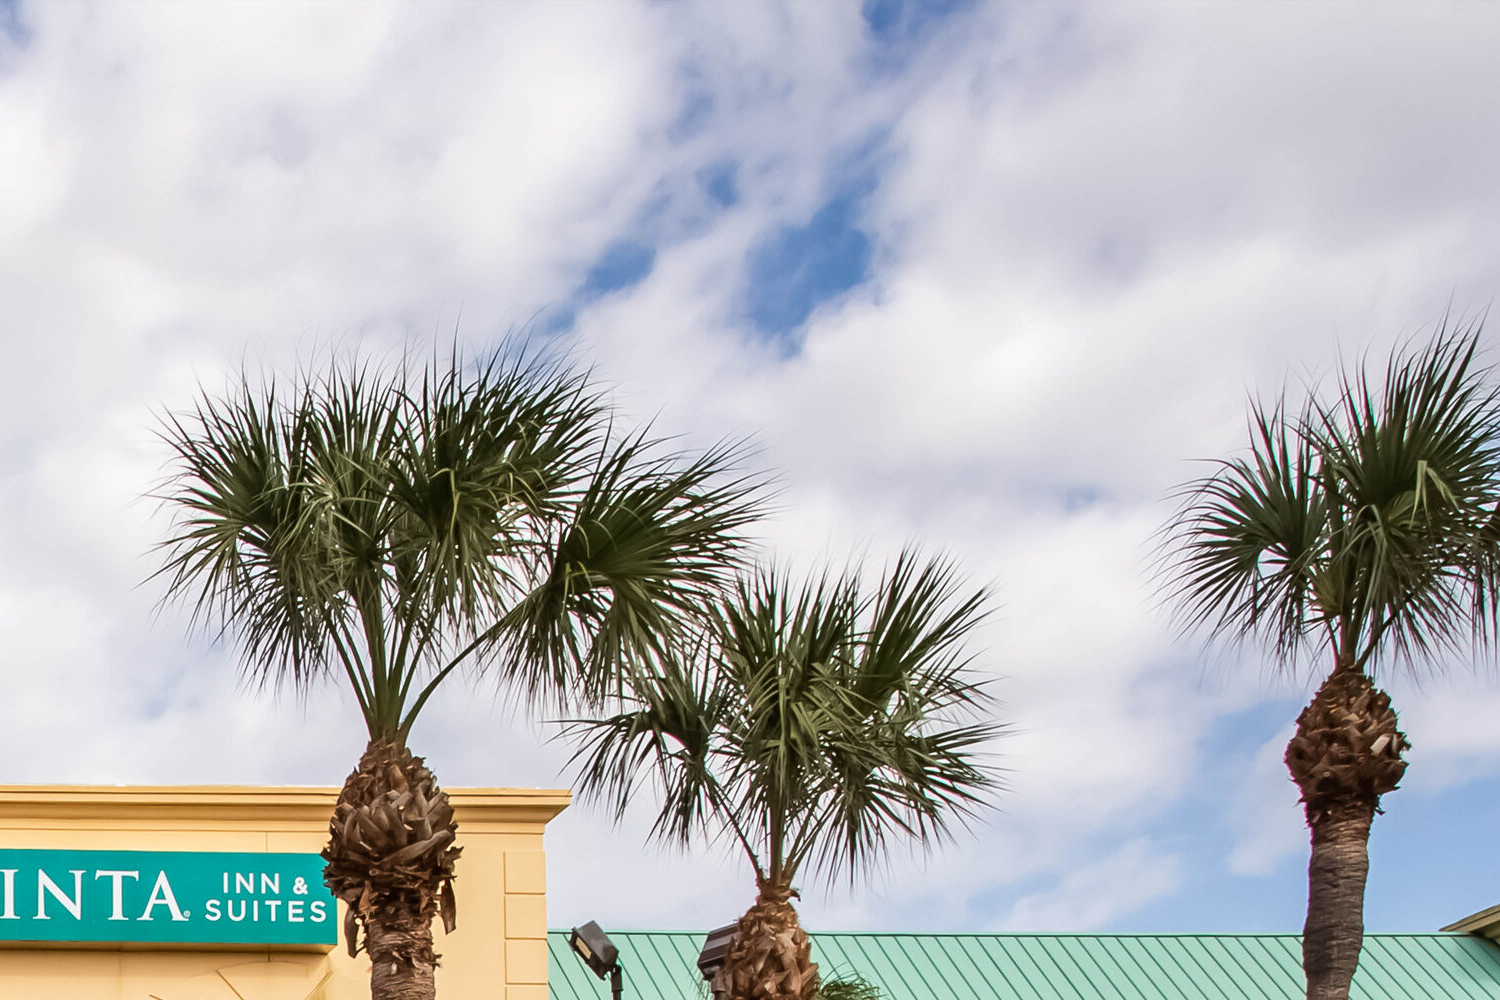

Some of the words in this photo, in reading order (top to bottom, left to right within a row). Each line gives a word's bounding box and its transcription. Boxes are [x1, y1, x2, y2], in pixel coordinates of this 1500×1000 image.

[223, 872, 280, 895] INN
[292, 876, 309, 895] &
[205, 899, 327, 923] SUITES
